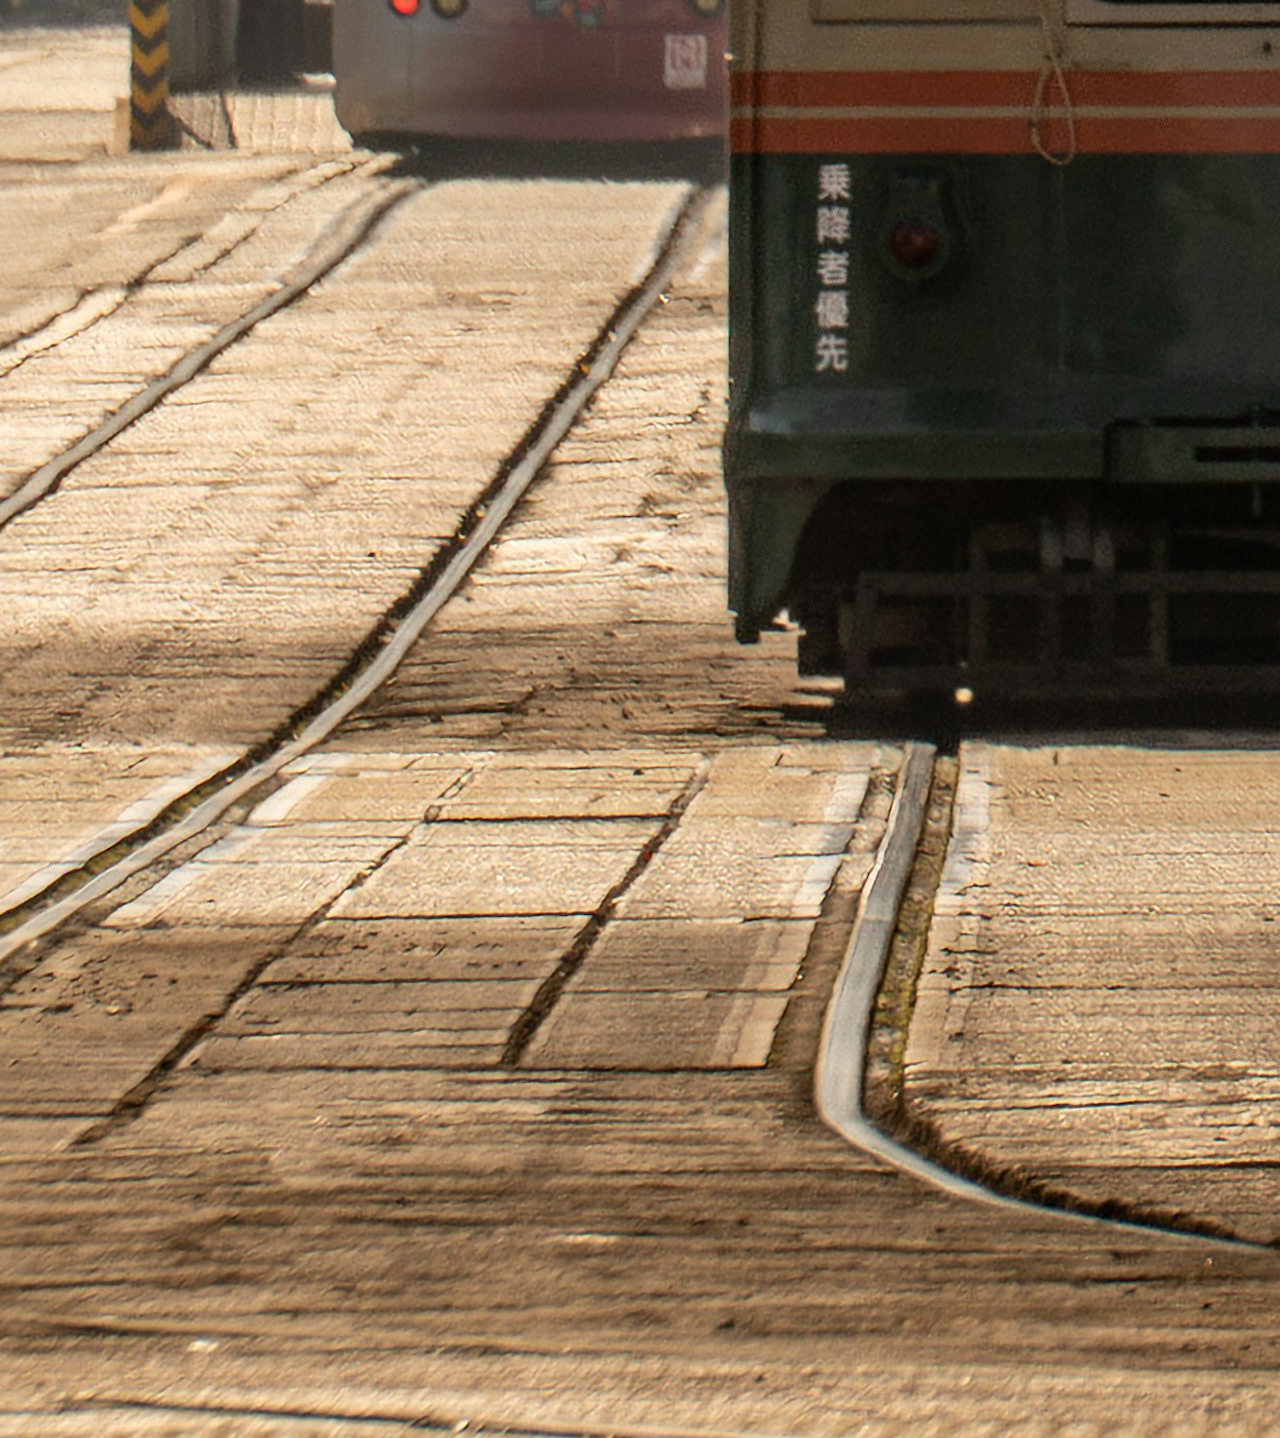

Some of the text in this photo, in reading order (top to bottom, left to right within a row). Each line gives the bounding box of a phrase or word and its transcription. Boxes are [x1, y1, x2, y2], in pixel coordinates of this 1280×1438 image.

[815, 163, 851, 372] 乗降者優先
